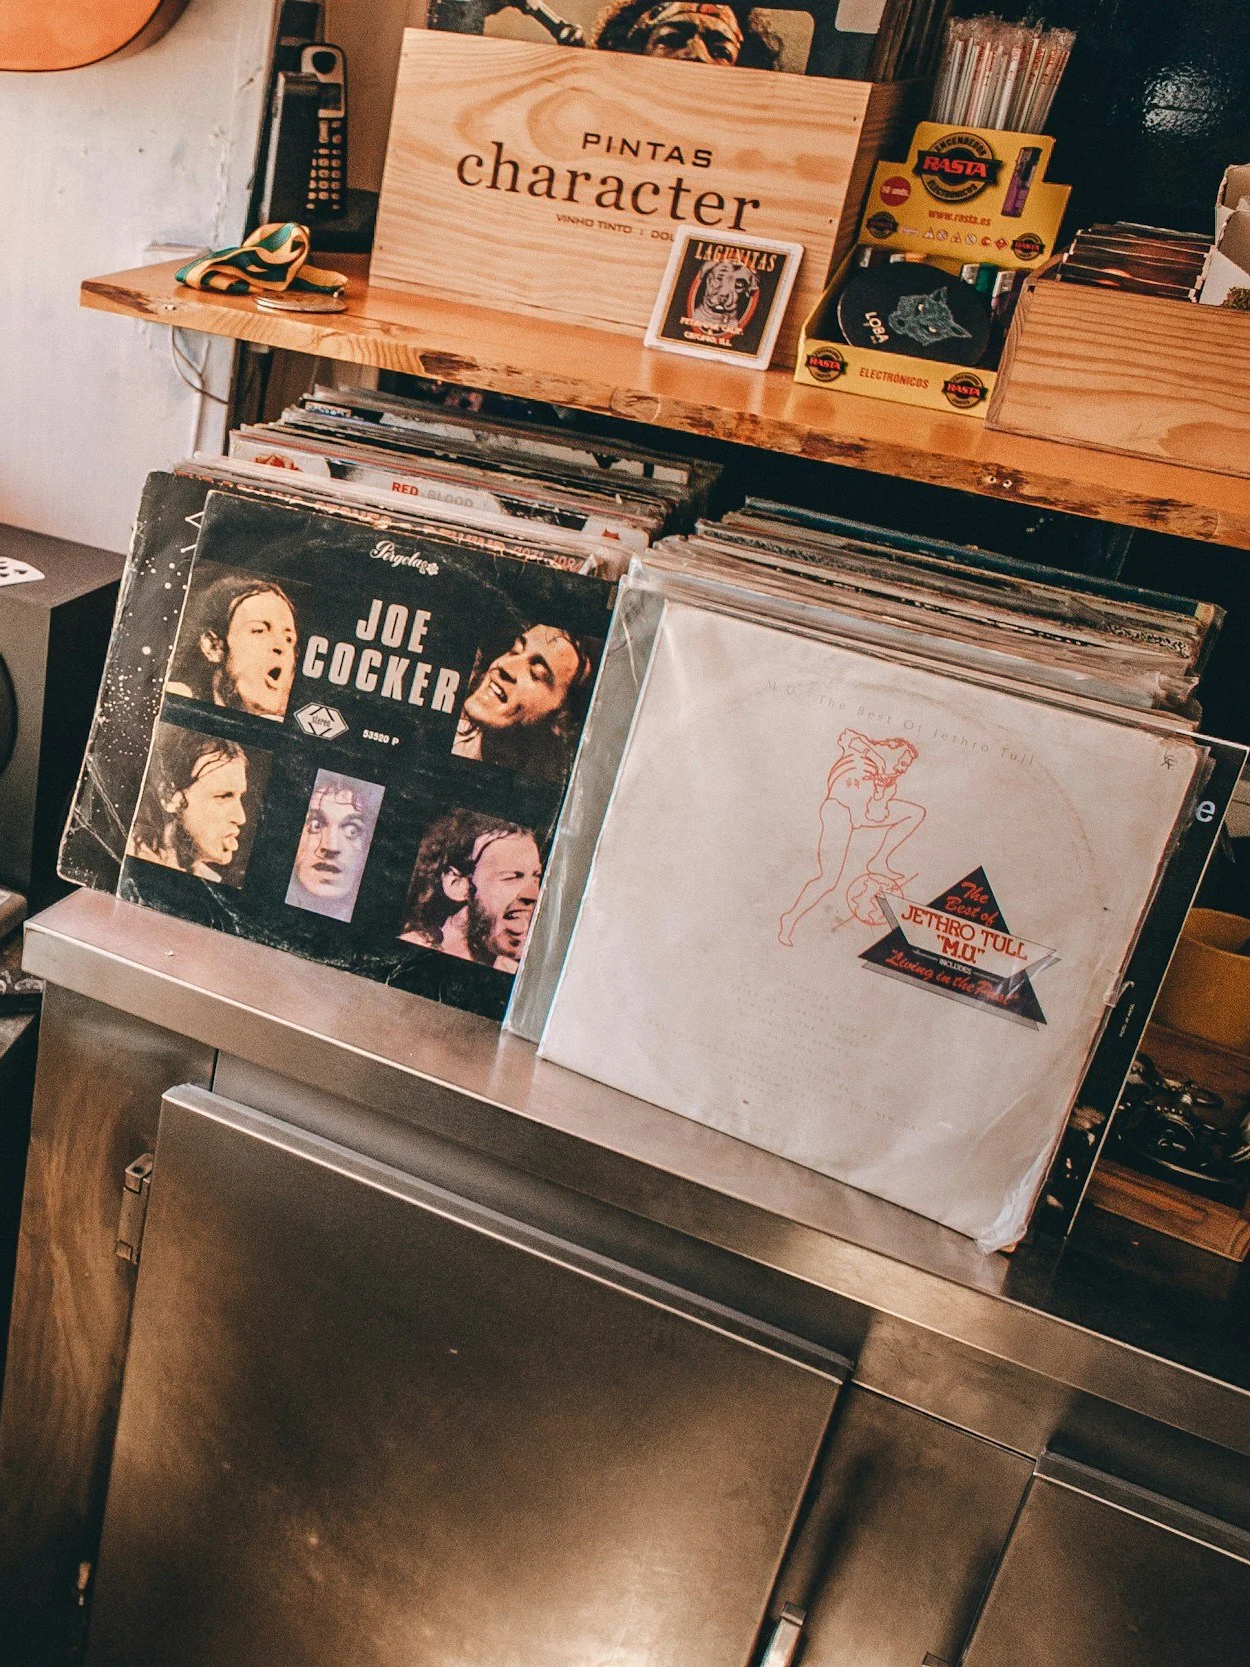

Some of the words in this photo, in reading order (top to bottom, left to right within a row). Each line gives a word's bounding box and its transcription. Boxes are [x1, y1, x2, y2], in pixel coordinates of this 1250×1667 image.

[582, 132, 713, 168] PINTAS
[922, 155, 987, 178] RASTA
[456, 141, 760, 231] character
[556, 213, 595, 228] VINHO
[597, 220, 633, 234] TINTO
[693, 241, 778, 273] LAGUNITAS
[808, 357, 842, 371] RASTA
[947, 383, 981, 398] RASTA
[391, 481, 420, 497] RED
[355, 599, 432, 654] JOE
[301, 634, 461, 714] COCKER
[362, 729, 390, 745] 53520
[390, 736, 400, 746] P
[857, 705, 893, 725] Best
[932, 728, 990, 753] Jethro
[1000, 746, 1035, 765] Tull
[960, 881, 989, 904] The
[944, 895, 982, 919] Best
[980, 909, 1000, 929] of
[900, 904, 976, 941] JETHRO
[980, 928, 1028, 961] TULL
[937, 958, 973, 976] INCLUDES
[936, 970, 952, 984] in
[952, 976, 975, 993] the
